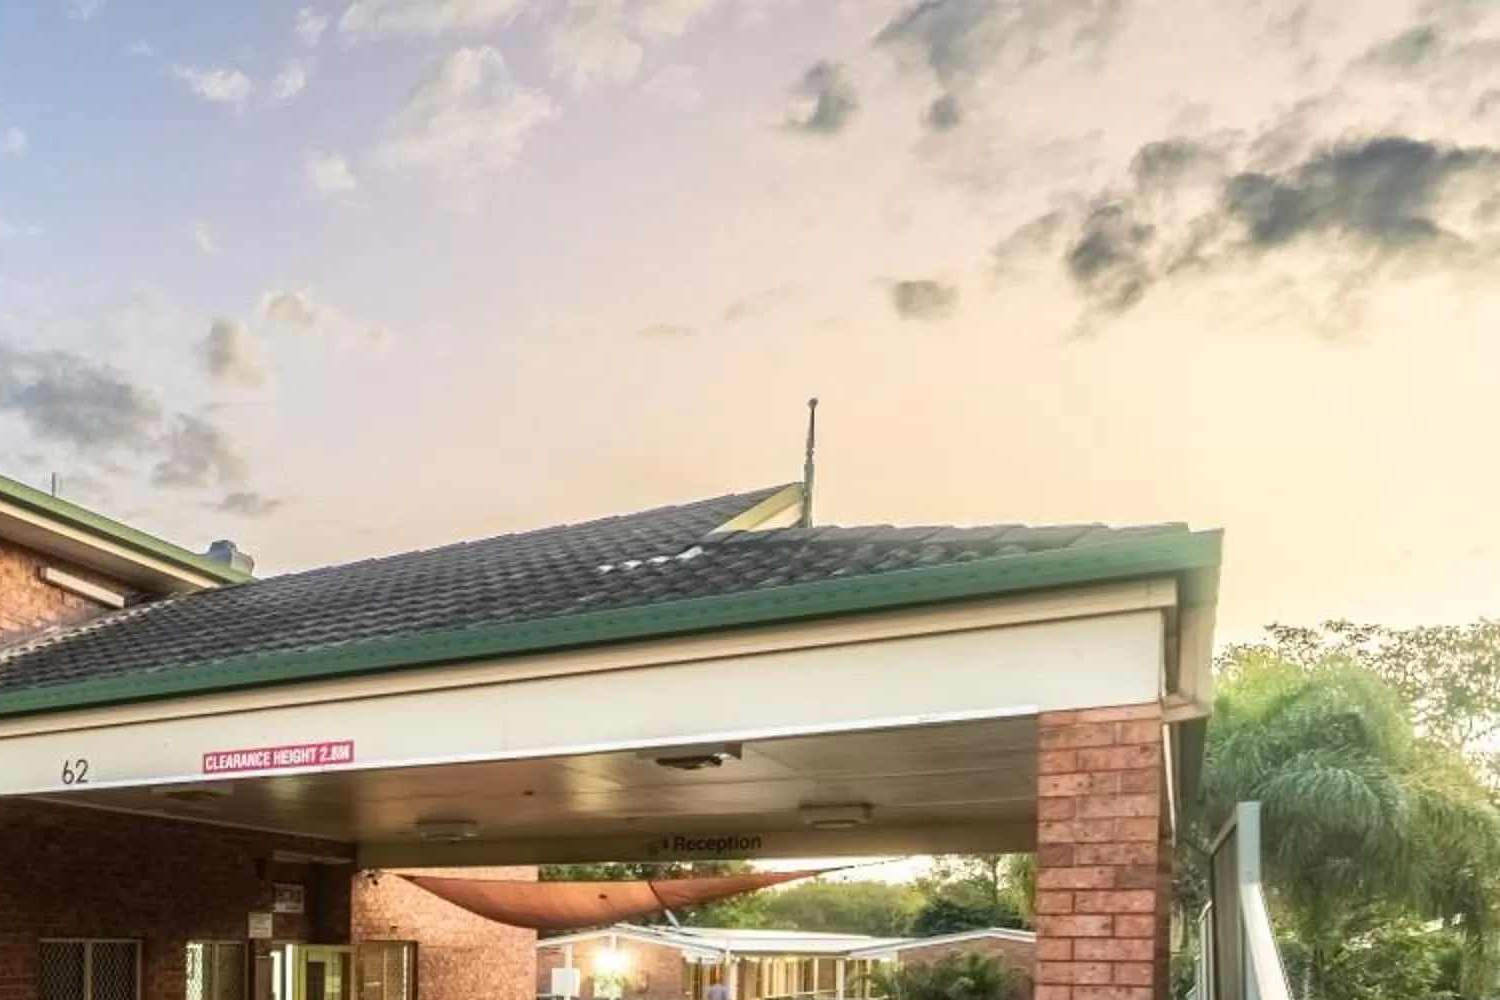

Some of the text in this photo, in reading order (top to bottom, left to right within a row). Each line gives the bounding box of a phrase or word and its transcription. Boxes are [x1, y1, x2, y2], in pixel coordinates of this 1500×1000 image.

[205, 752, 271, 771] CLEARANCE
[273, 747, 317, 765] HEIGHT
[62, 759, 89, 785] 62
[673, 835, 762, 854] Reception
